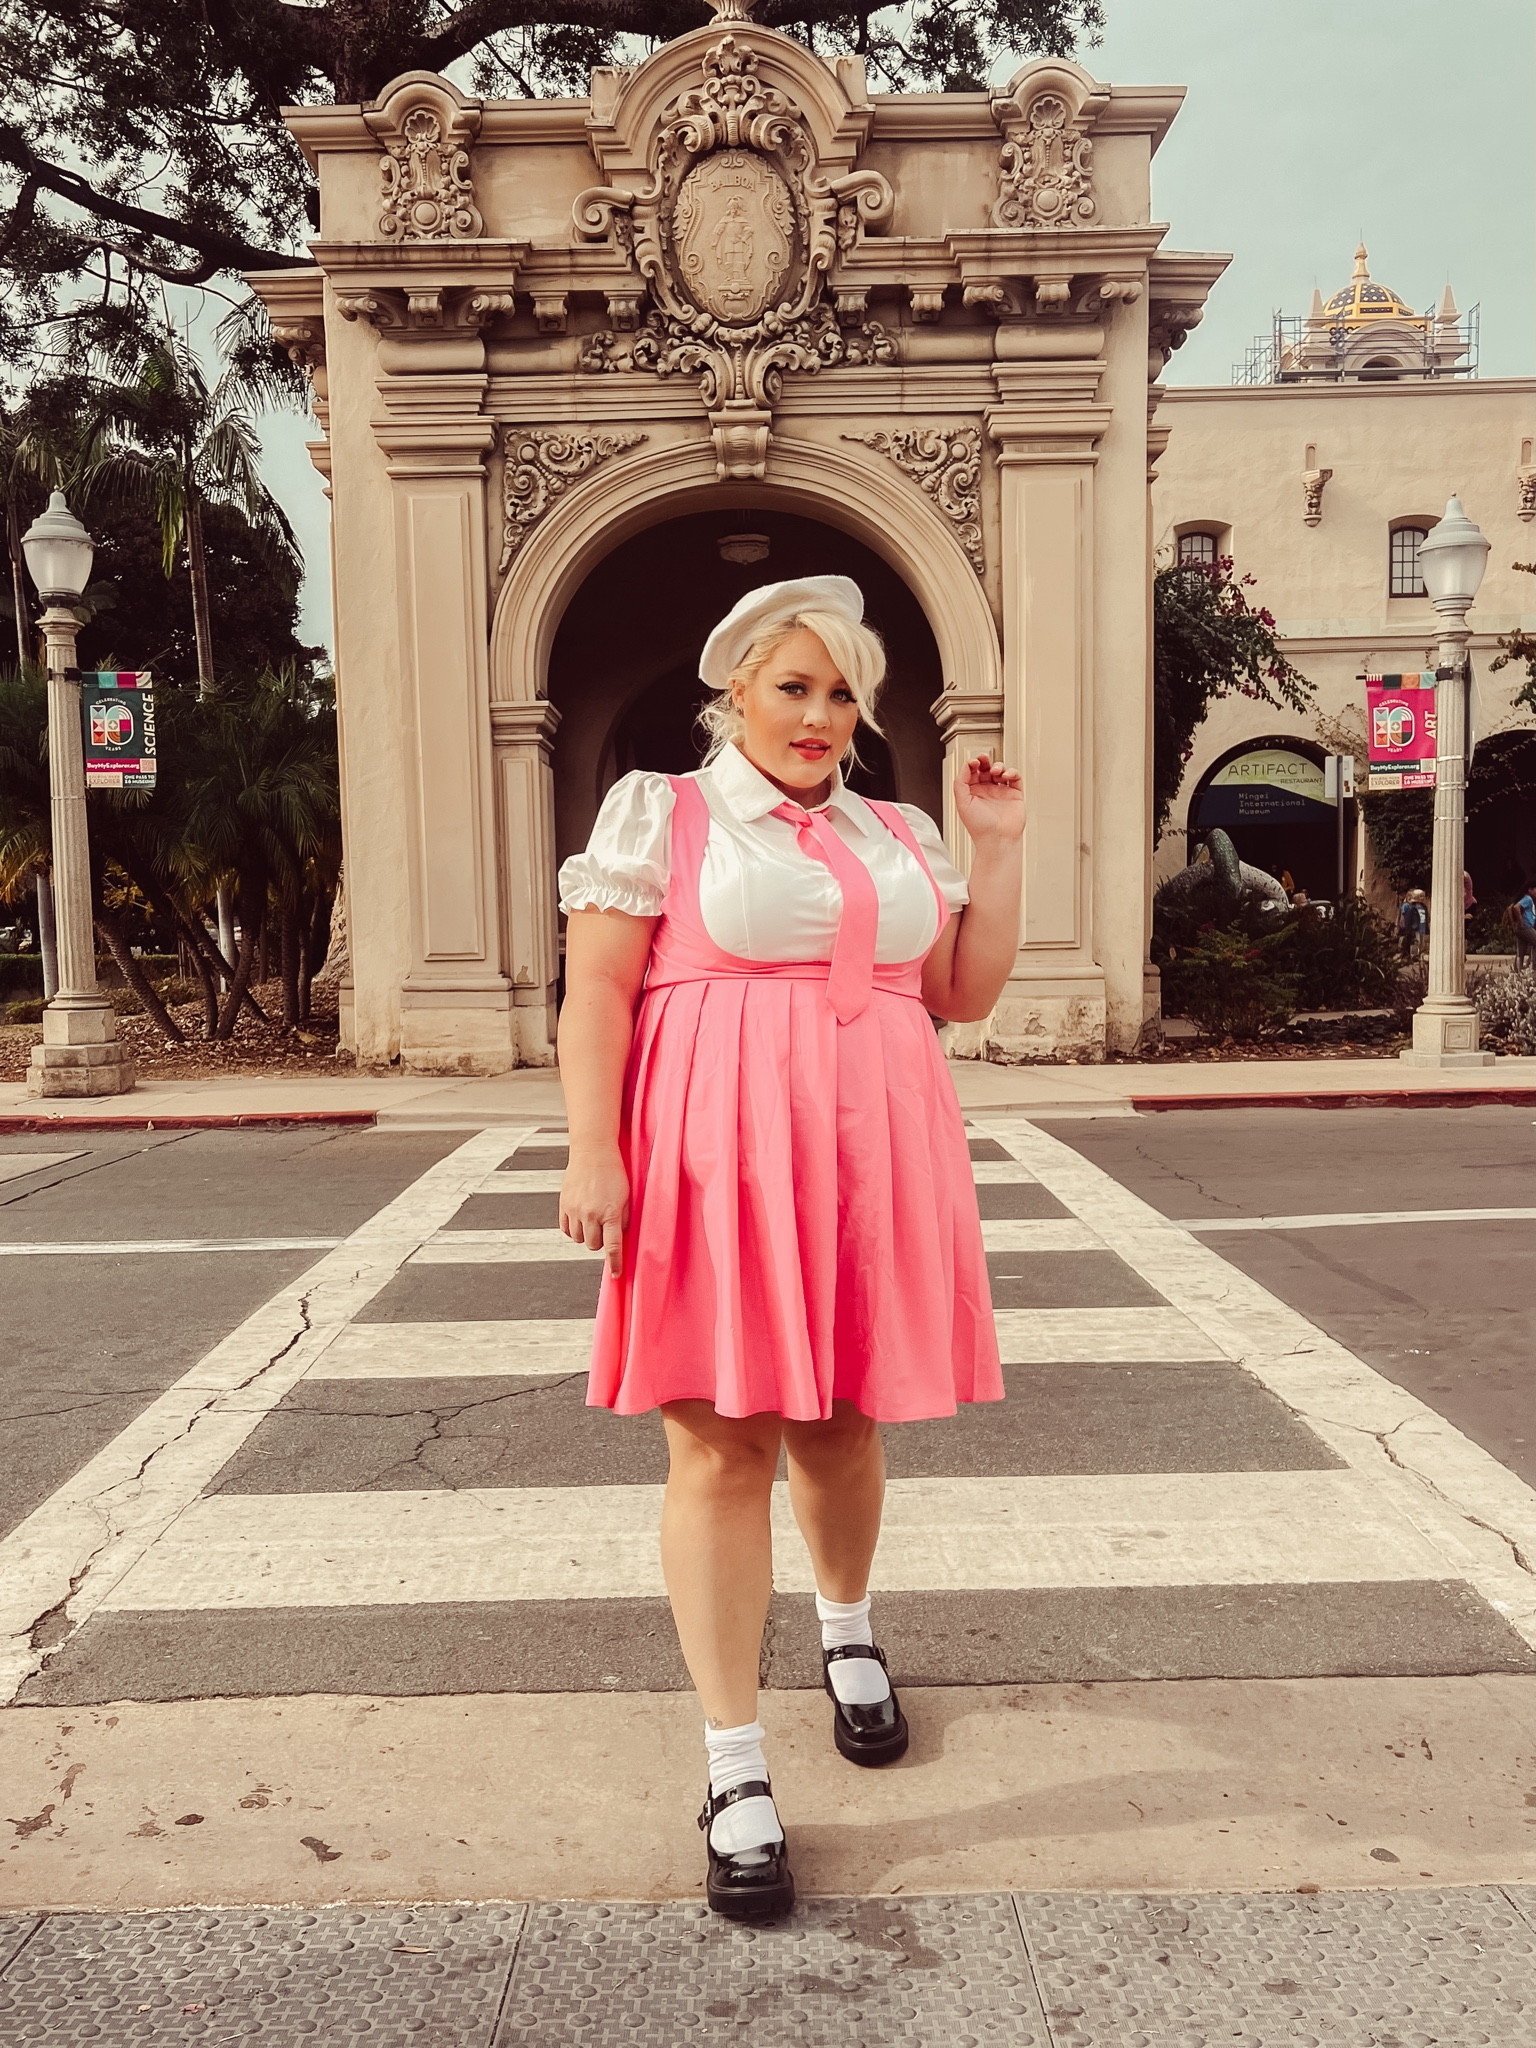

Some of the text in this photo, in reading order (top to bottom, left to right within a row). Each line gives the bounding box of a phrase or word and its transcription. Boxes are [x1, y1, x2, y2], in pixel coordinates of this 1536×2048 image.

[709, 175, 756, 192] BALBOA
[90, 704, 134, 746] 10
[142, 693, 157, 756] SCIENCE
[1373, 706, 1415, 748] 10
[1424, 710, 1437, 740] ART
[1228, 762, 1308, 777] ARTIFACT
[1280, 777, 1323, 785] RESTAURANT
